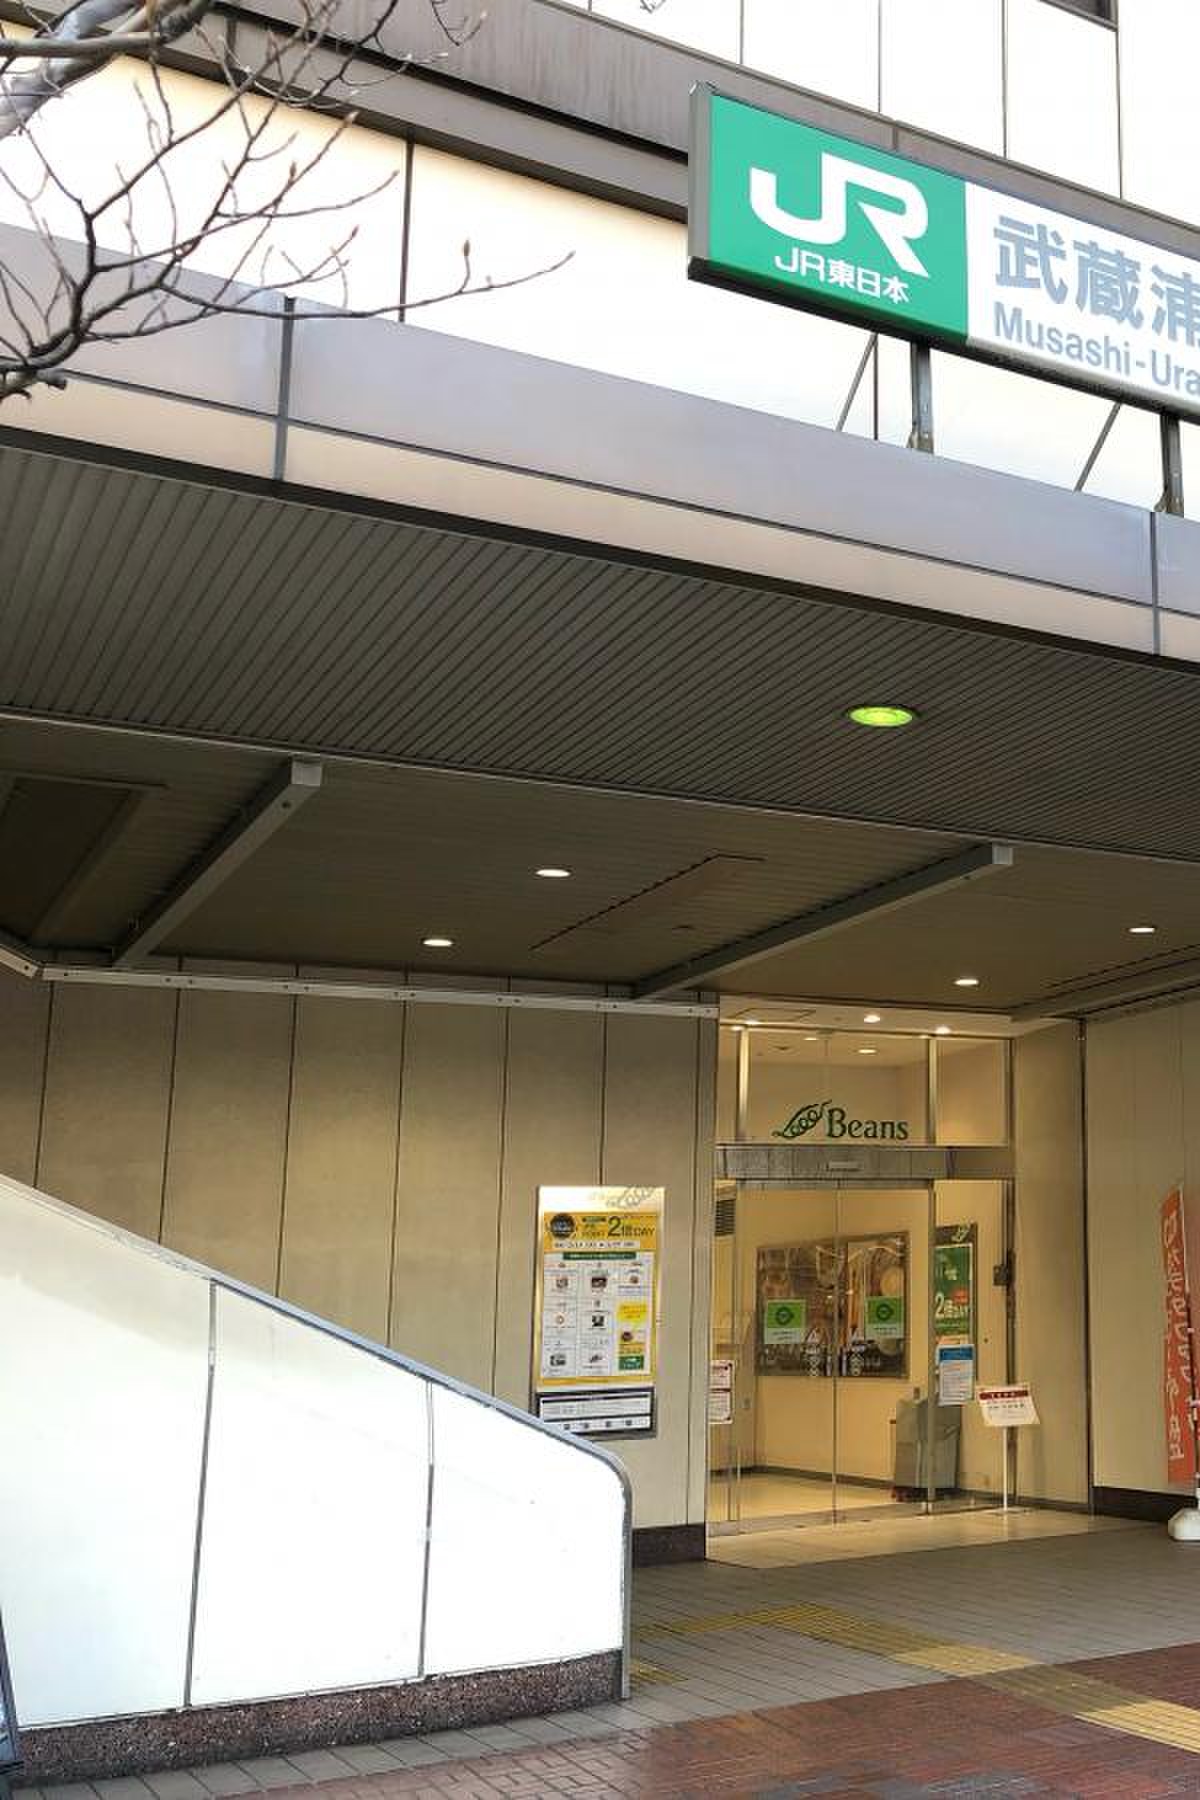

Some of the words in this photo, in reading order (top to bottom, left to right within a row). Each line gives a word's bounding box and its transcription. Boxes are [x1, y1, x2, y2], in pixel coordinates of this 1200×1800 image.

[750, 151, 930, 279] JR
[774, 247, 911, 304] JR東日本
[826, 1107, 908, 1140] Beans
